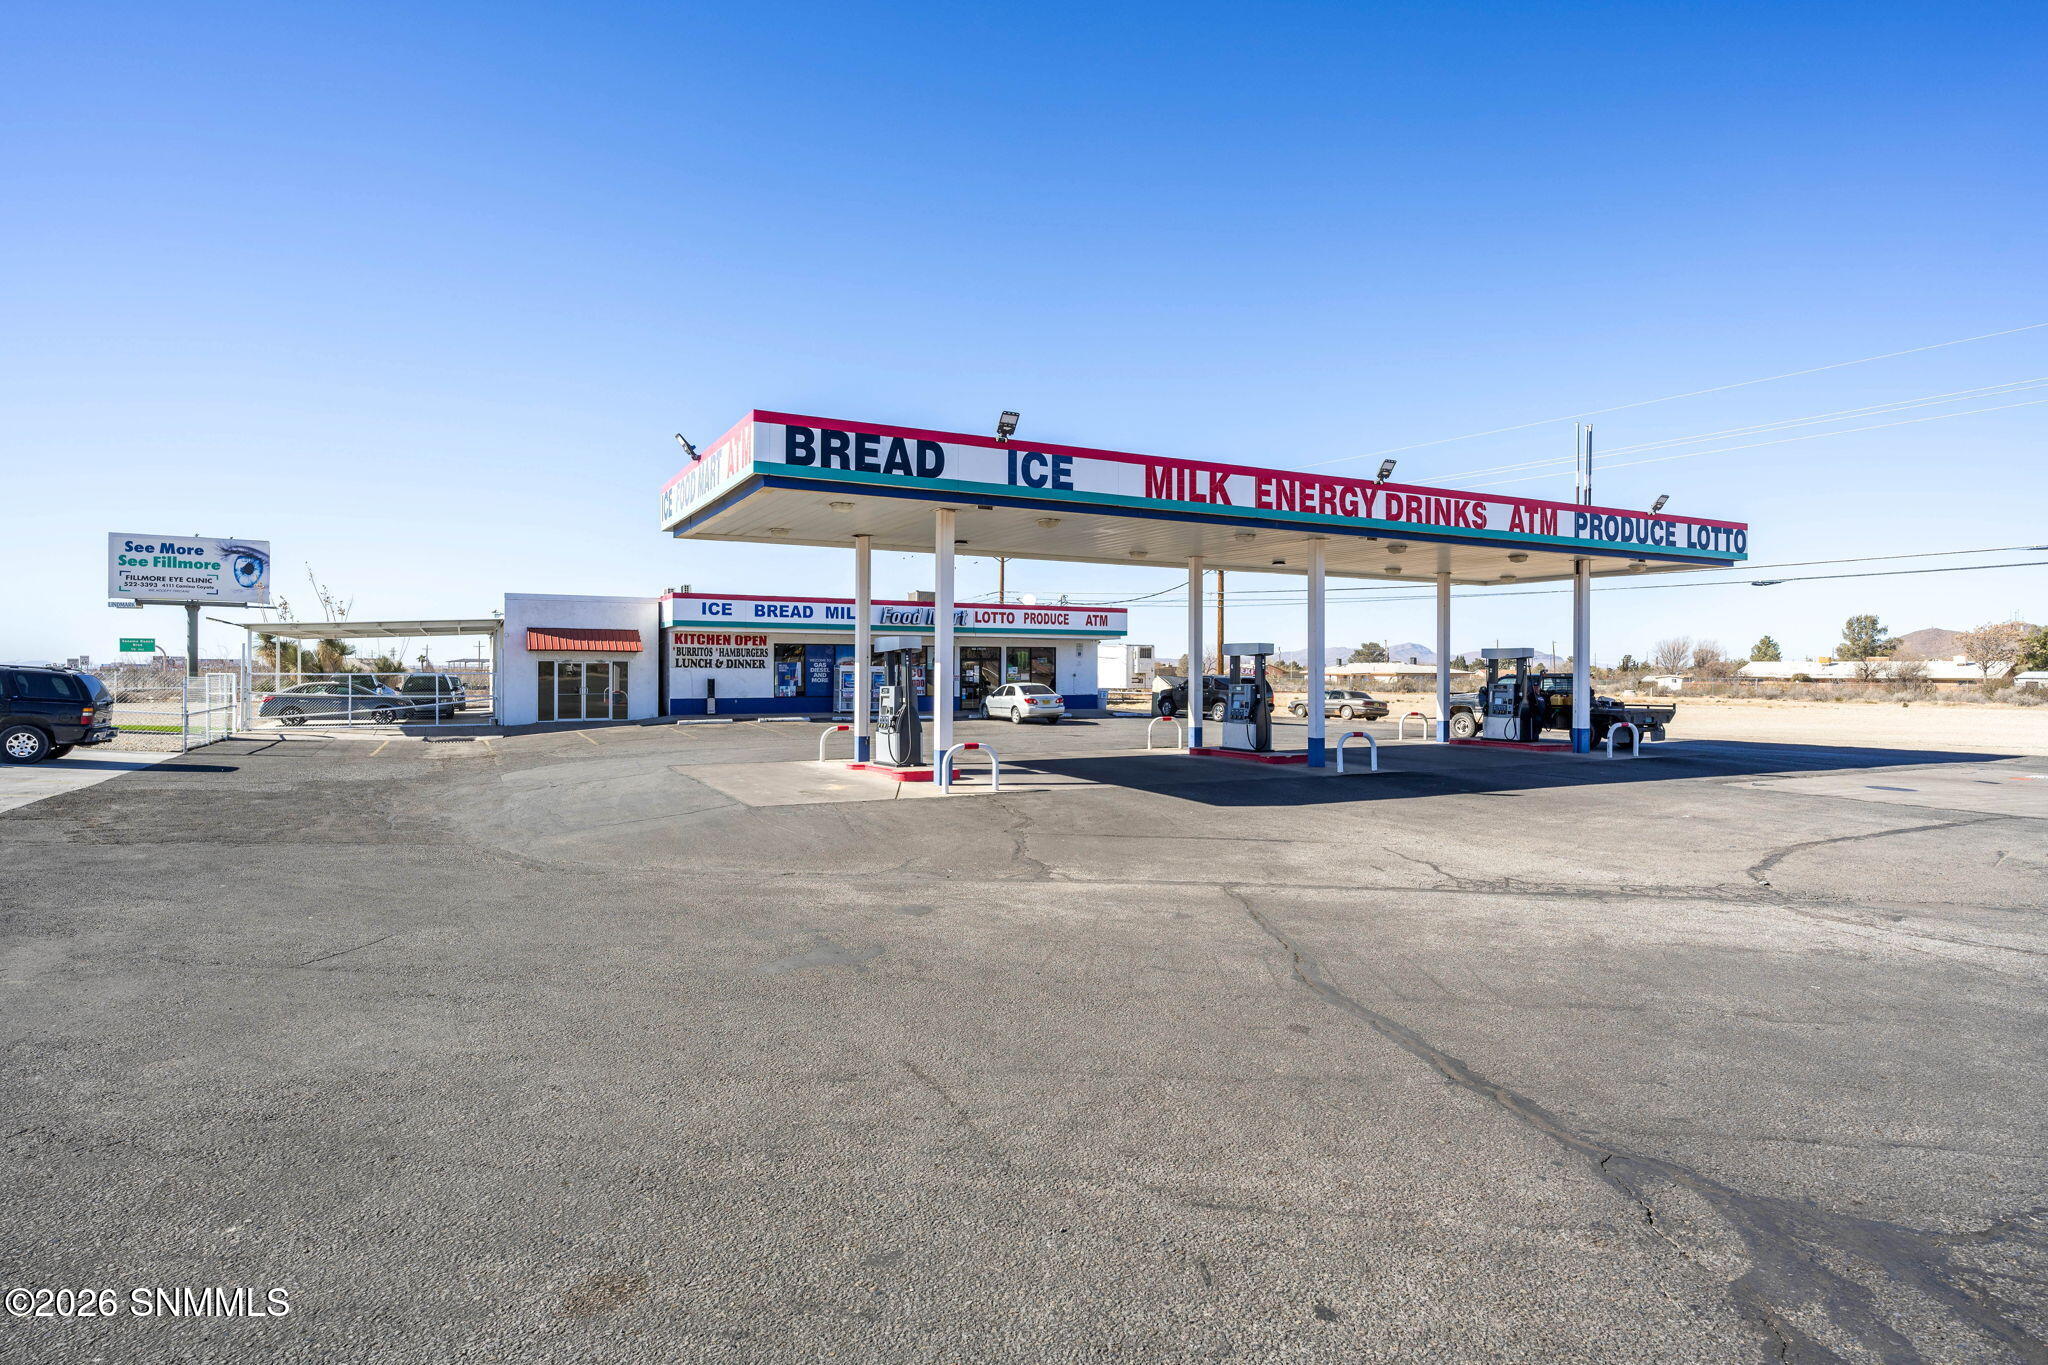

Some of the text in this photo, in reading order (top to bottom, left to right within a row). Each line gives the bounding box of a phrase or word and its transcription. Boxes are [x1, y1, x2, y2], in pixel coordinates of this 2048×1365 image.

[661, 424, 752, 522] ICE FOOD MART ATM
[786, 425, 1747, 554] BREAD ICE MILK ENERGY DRINKS ATM PRODUCE LOTTO
[125, 540, 204, 556] See More
[118, 554, 221, 570] See Fillmore
[701, 602, 856, 620] ICE BREAD MIL
[880, 606, 923, 624] Food
[974, 610, 1109, 627] LOTTO PRODUCE ATM
[674, 633, 767, 647] KITCHEN OPEN
[675, 658, 766, 669] LUNCH & DINNER
